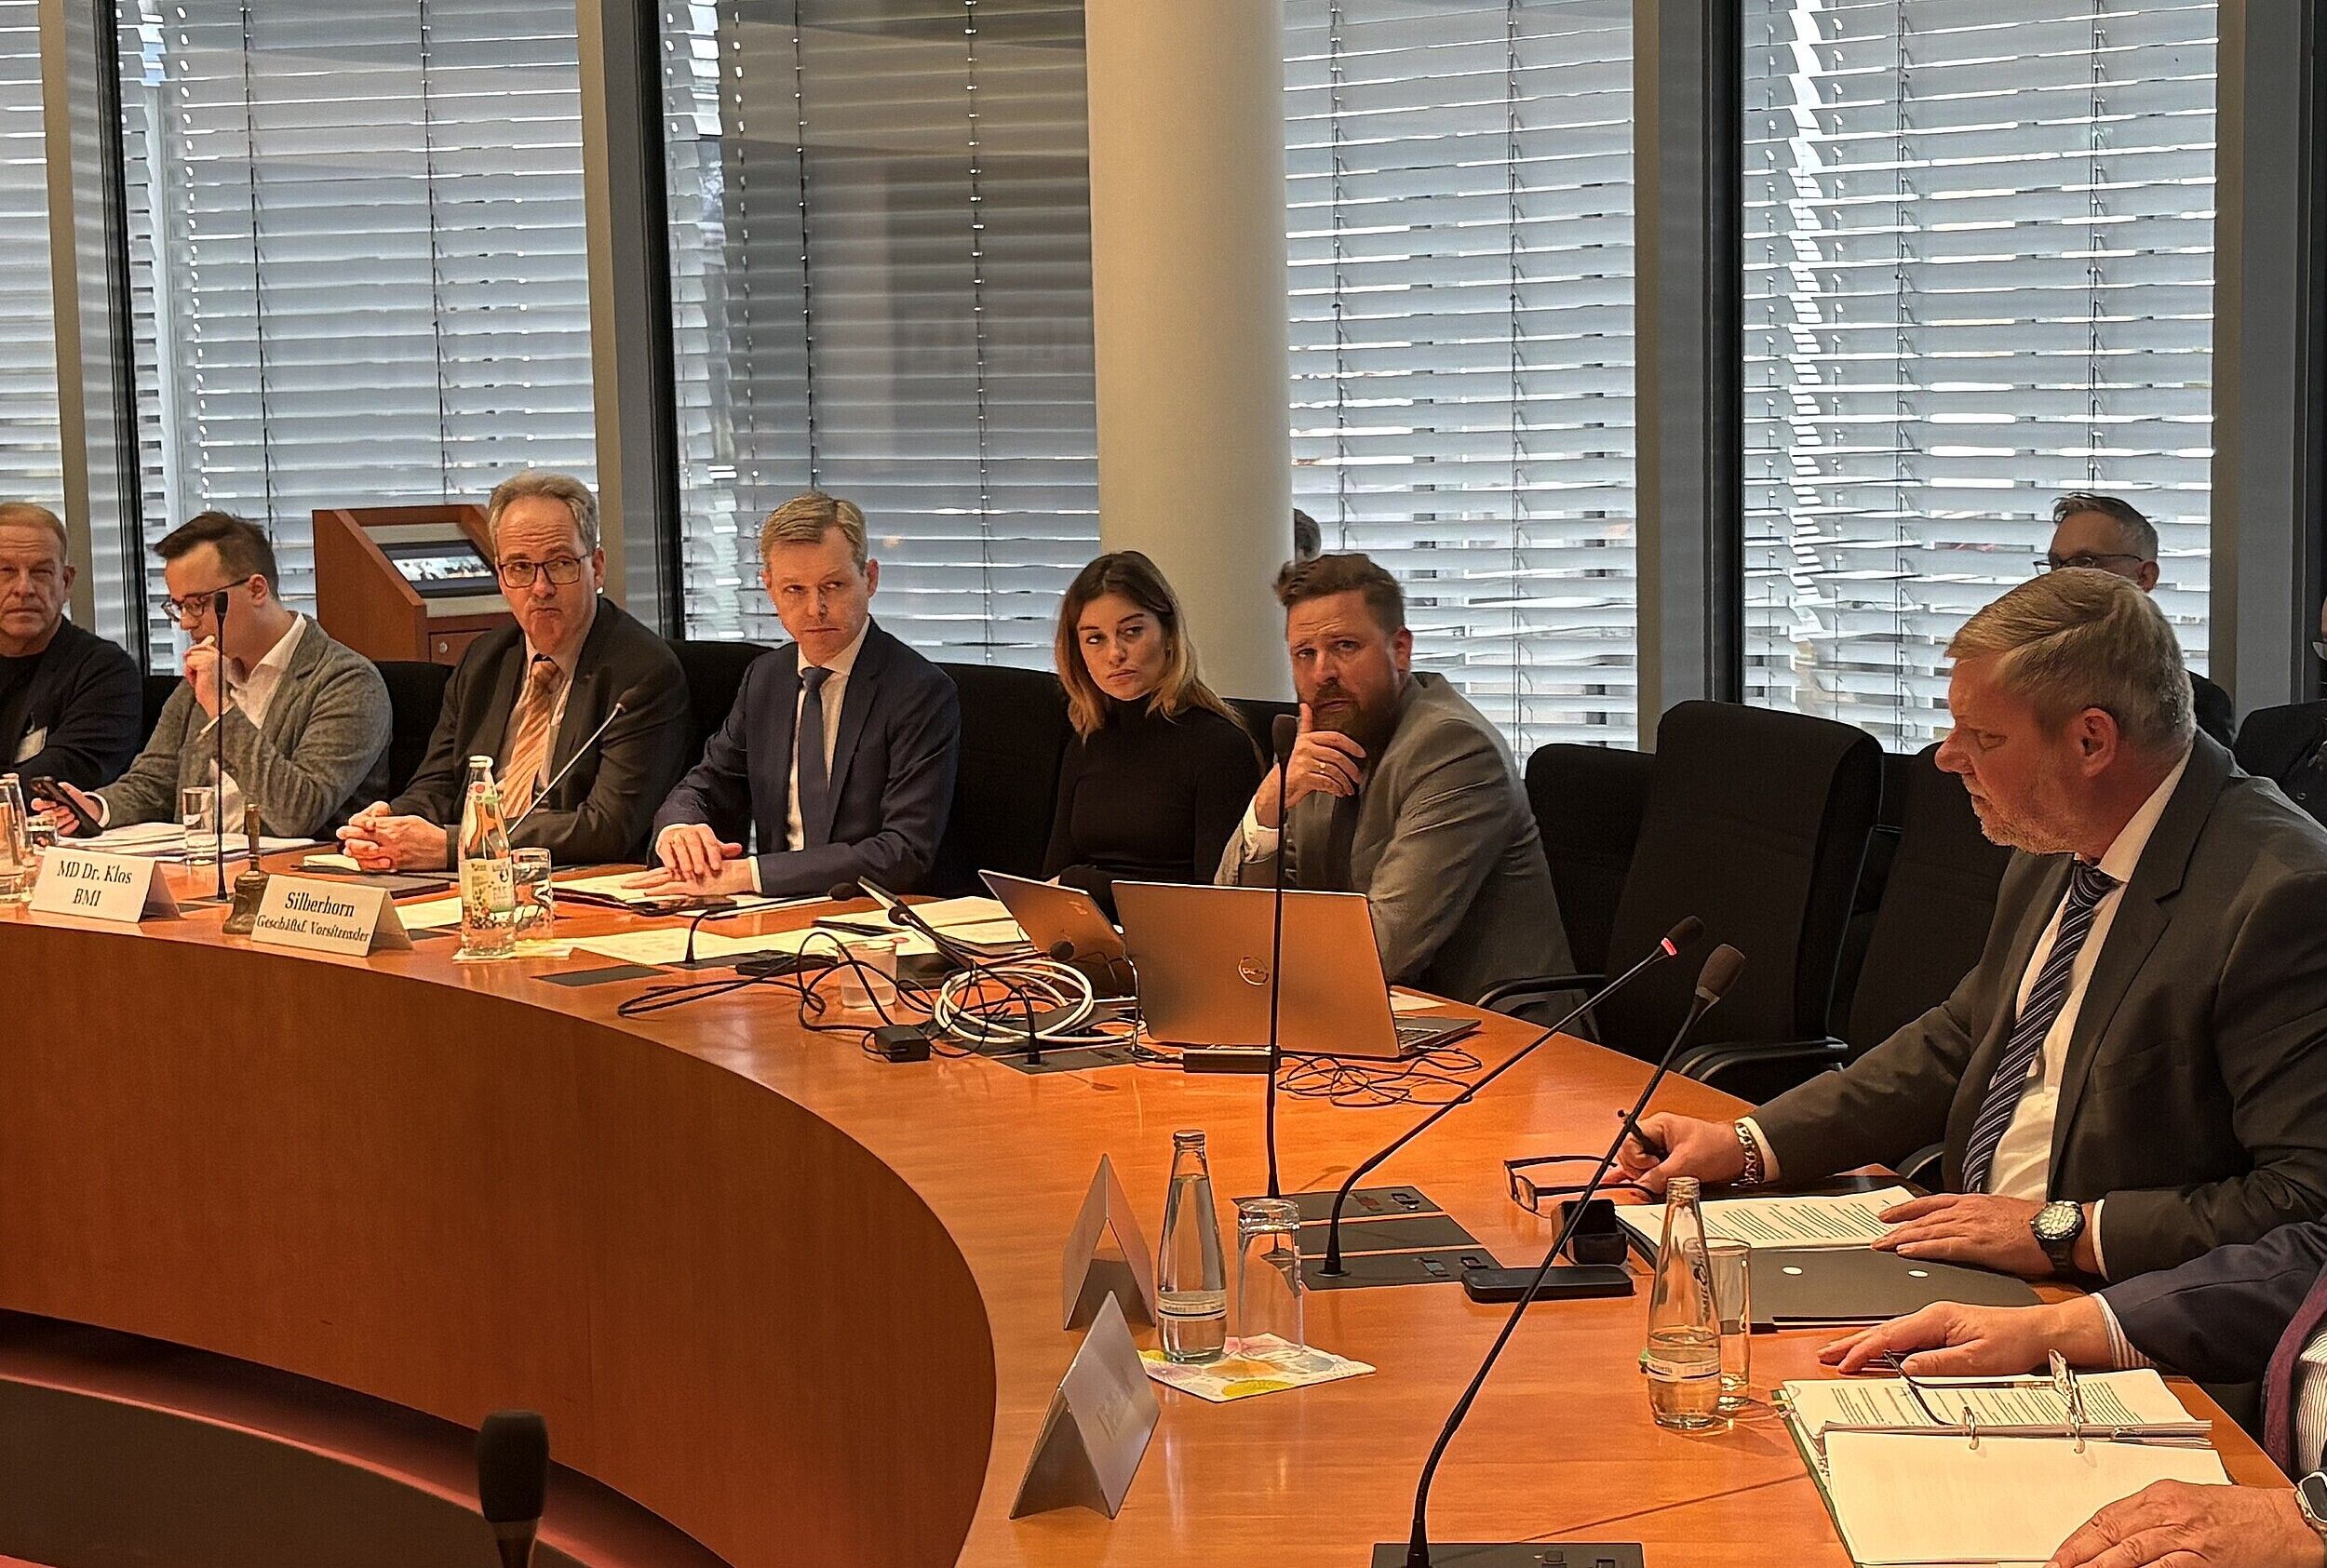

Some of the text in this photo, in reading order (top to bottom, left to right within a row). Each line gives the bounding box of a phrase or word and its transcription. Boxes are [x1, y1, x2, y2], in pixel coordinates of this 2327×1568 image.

[57, 860, 132, 884] MD Dr. Klos
[73, 888, 101, 906] BMI
[284, 891, 355, 918] Silberhorn
